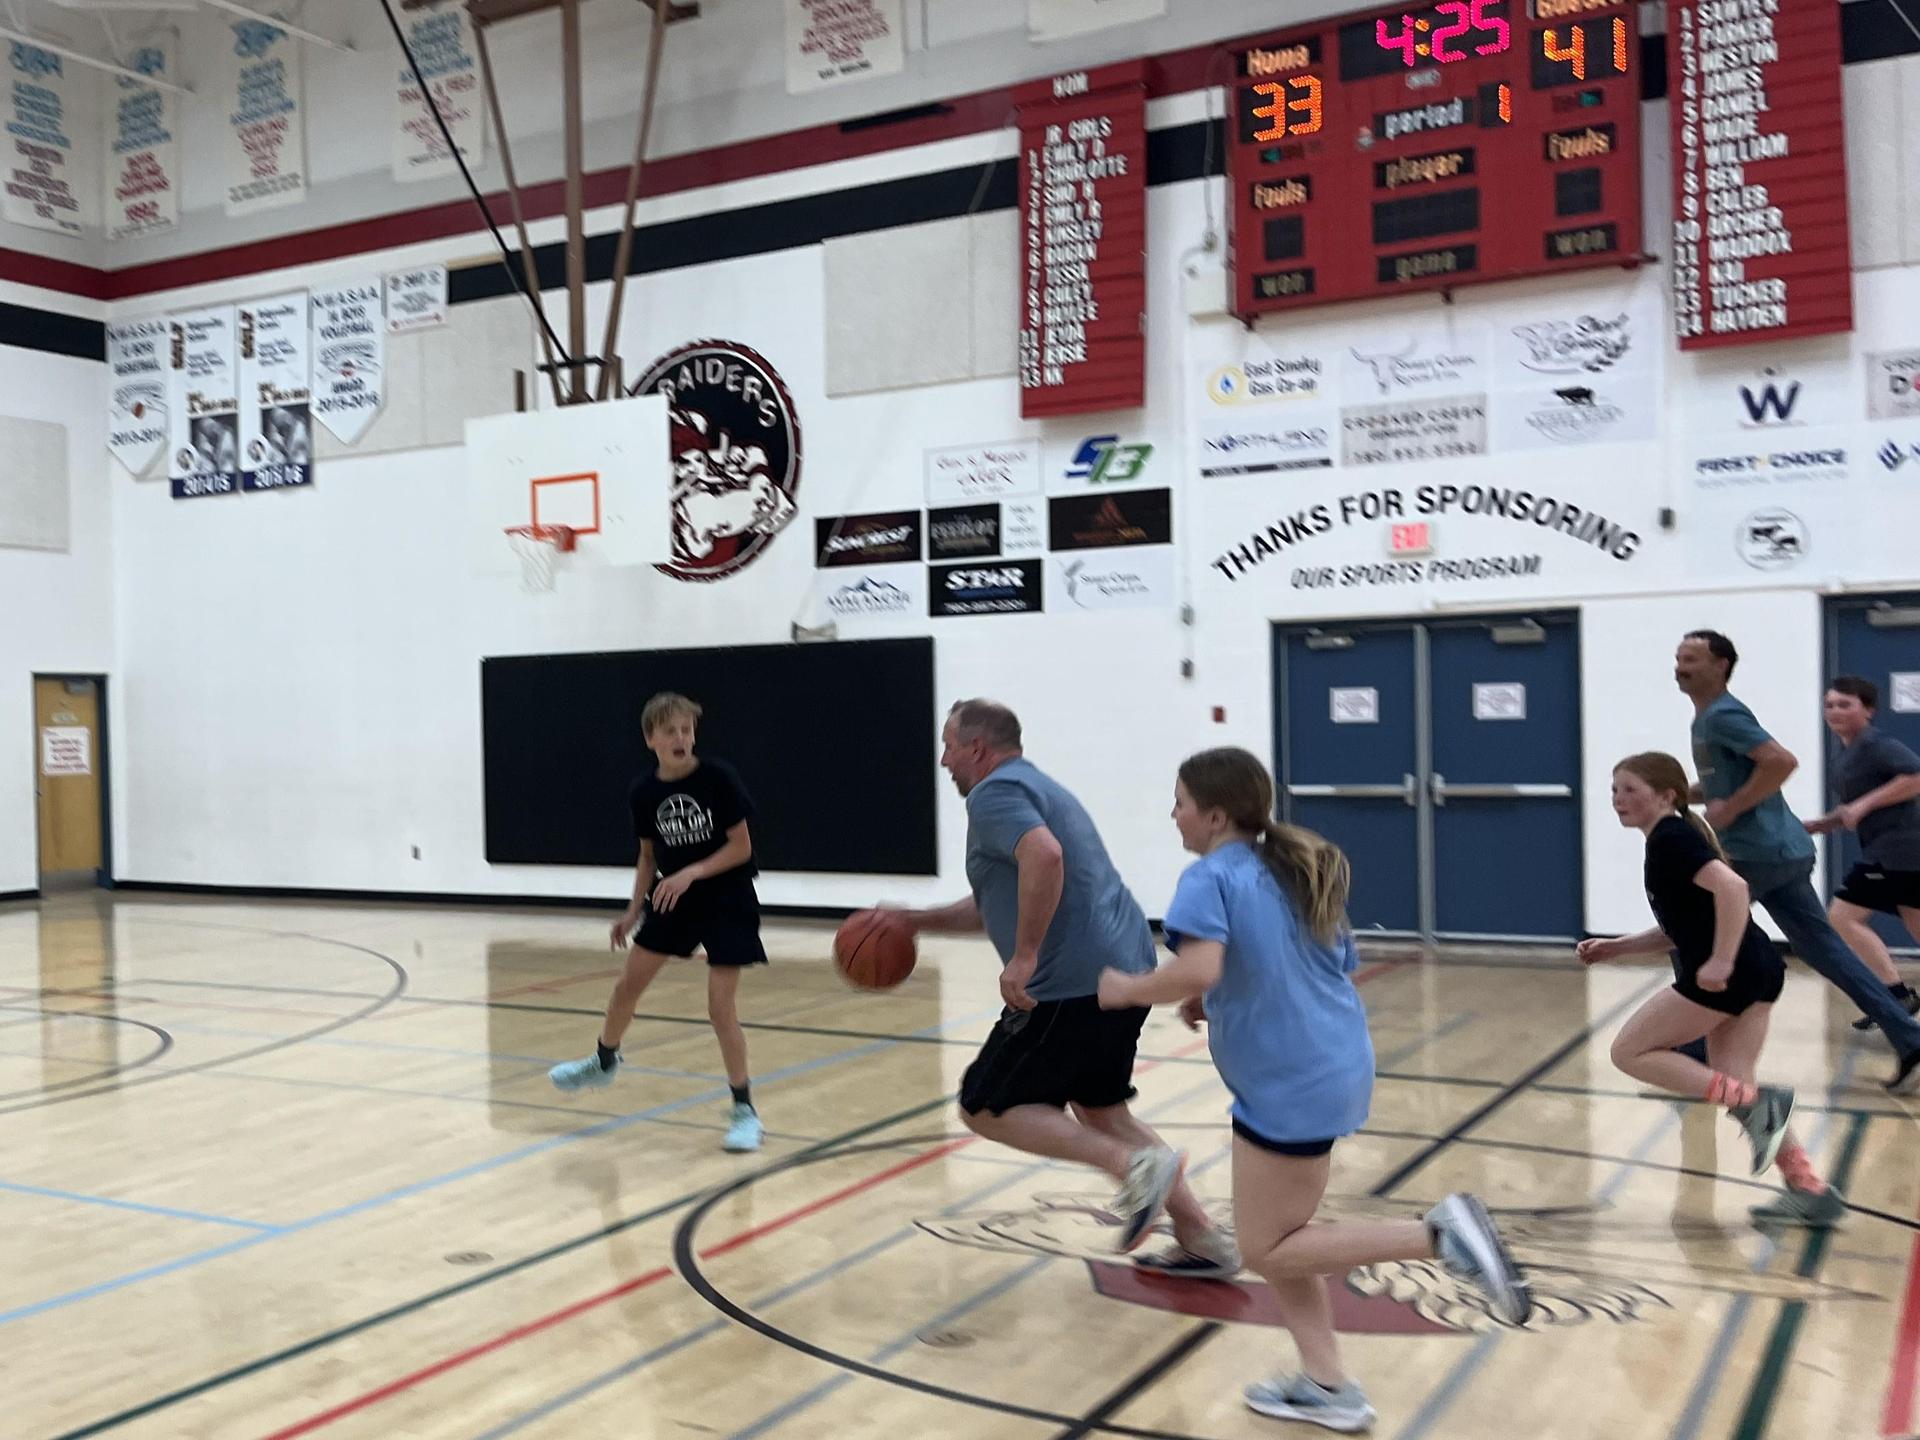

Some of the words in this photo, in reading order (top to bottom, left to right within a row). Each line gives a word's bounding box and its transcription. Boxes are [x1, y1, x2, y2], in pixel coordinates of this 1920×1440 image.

[1376, 0, 1511, 67] 4:25
[1543, 17, 1628, 80] 41
[1247, 45, 1311, 77] Home
[1700, 39, 1779, 72] WESTON
[1253, 75, 1323, 141] 33
[1385, 97, 1464, 140] period
[1499, 83, 1512, 124] 1
[1068, 116, 1112, 142] GIRLS
[1704, 132, 1788, 165] WILLIAM
[1386, 153, 1464, 190] player
[1683, 195, 1699, 218] 9
[1674, 219, 1700, 243] 10
[1674, 244, 1699, 267] 11
[1674, 266, 1700, 290] 12
[1675, 290, 1702, 314] 13
[1711, 278, 1787, 309] TUCKER
[657, 358, 778, 427] RAIDERS
[1738, 379, 1803, 424] W
[1695, 454, 1757, 475] FIRST
[1767, 448, 1848, 470] CHOICE
[1212, 500, 1334, 584] THANKS
[1339, 487, 1404, 526] FOR
[1416, 482, 1641, 563] SPONSORING
[945, 566, 1026, 592] STAR
[1290, 565, 1335, 590] OUR
[1339, 558, 1424, 586] SPORTS
[1427, 552, 1544, 583] PROGRAM
